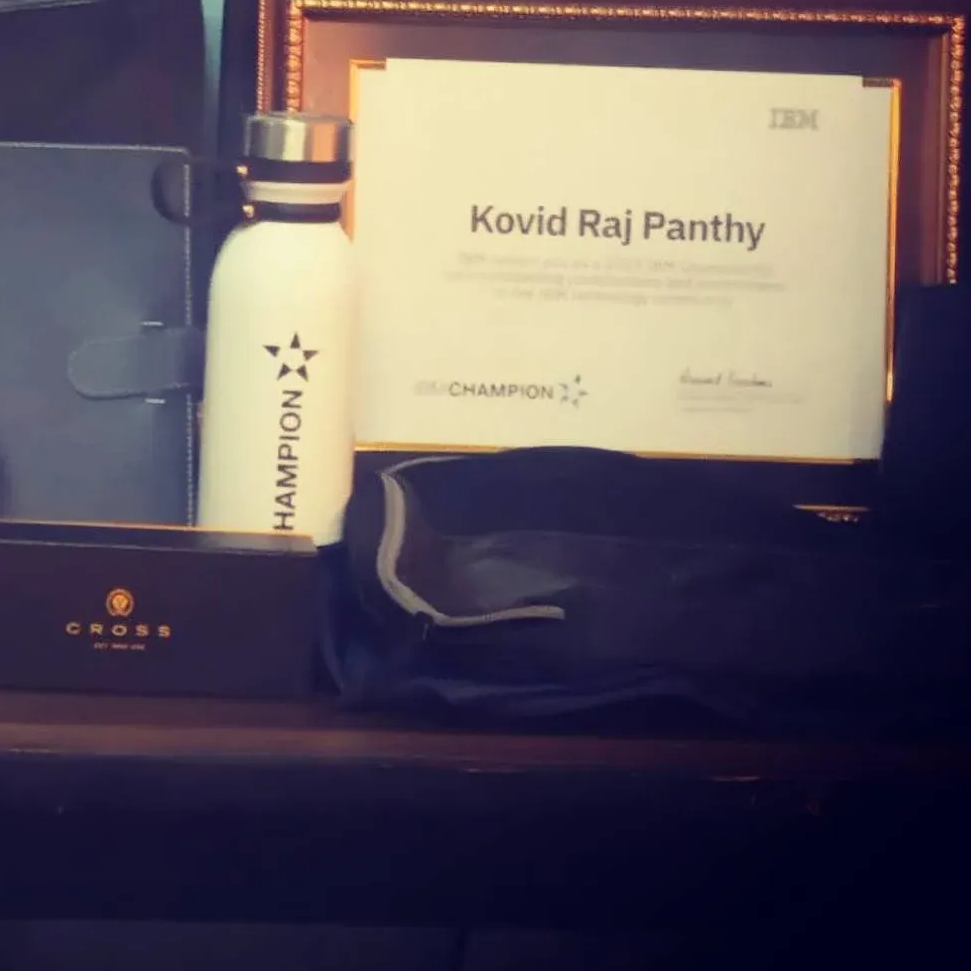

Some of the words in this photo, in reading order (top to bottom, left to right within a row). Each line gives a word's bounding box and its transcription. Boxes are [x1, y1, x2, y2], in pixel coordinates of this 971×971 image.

[769, 108, 819, 131] IBM
[470, 204, 568, 237] Kovid
[578, 208, 633, 246] Raj
[642, 210, 767, 252] Panthy
[65, 622, 171, 638] CROSS
